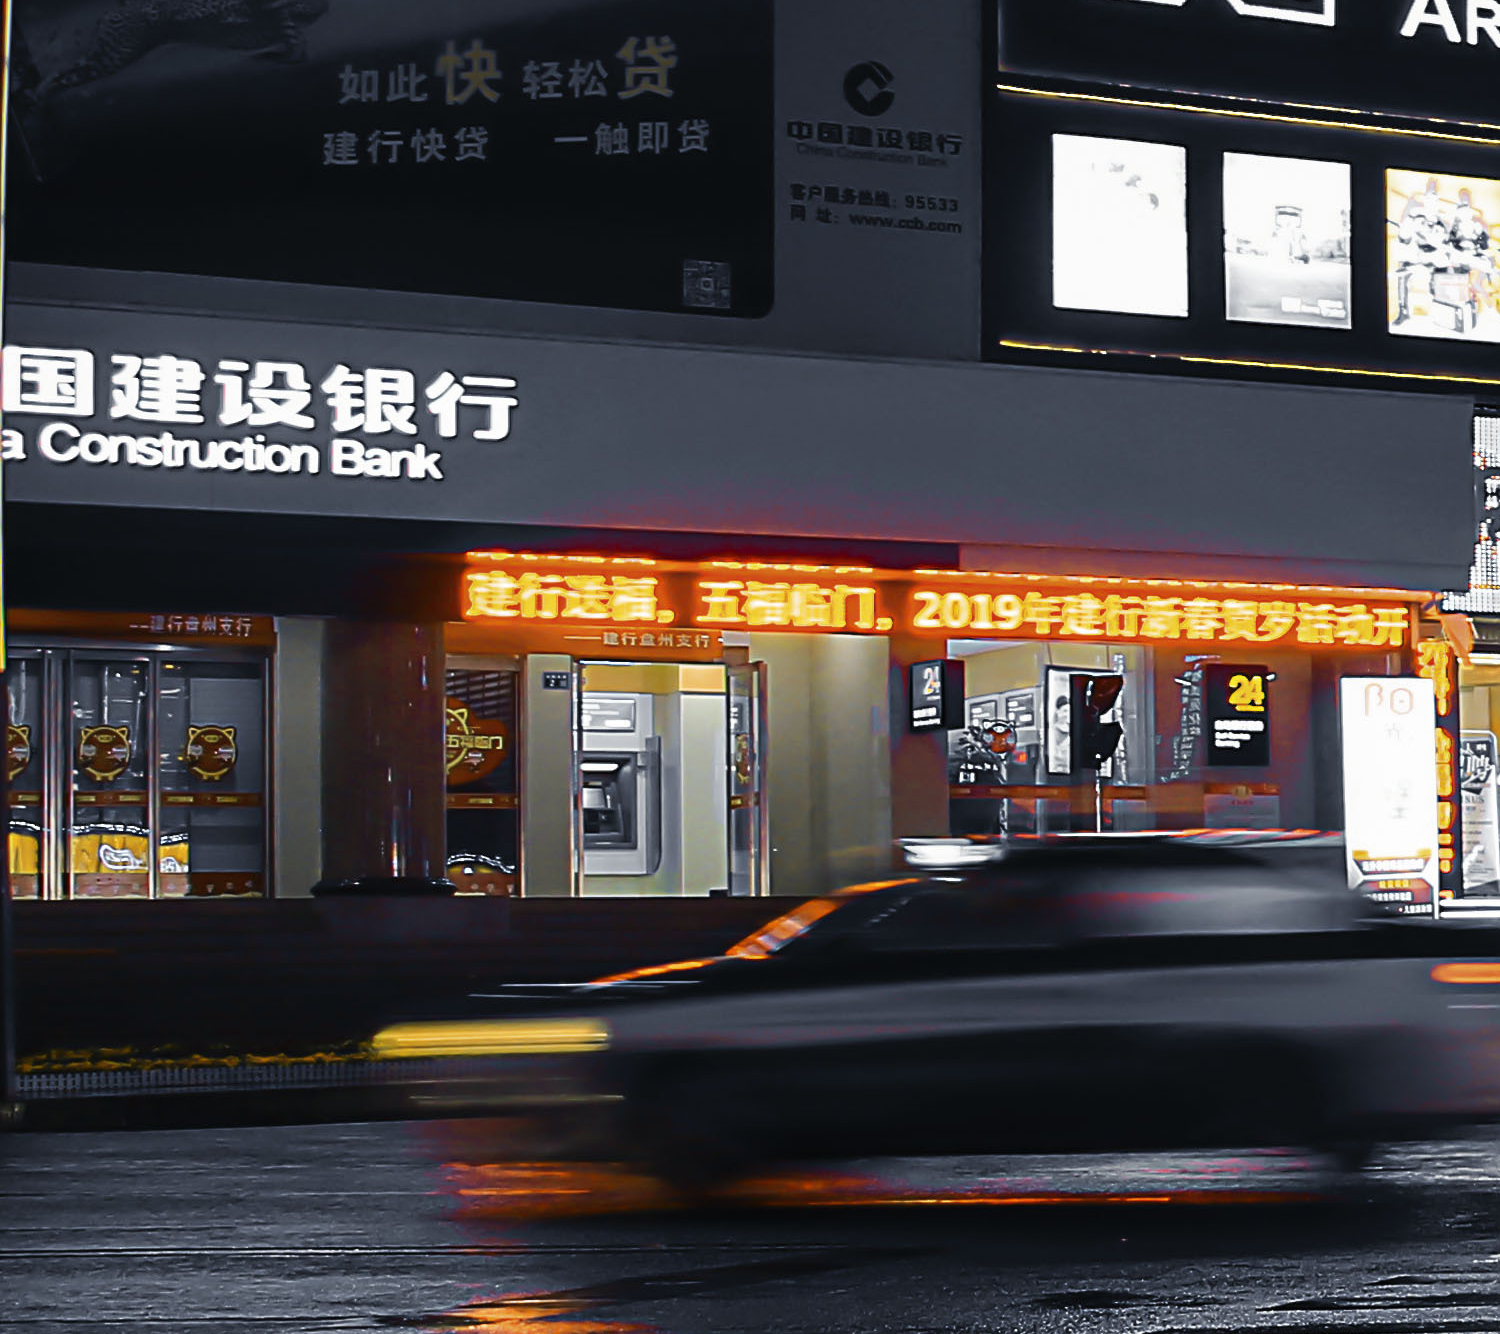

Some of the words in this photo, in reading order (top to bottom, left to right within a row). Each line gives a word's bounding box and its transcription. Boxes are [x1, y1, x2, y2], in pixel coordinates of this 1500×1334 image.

[337, 38, 503, 106] 如此快
[521, 35, 679, 100] 轻松贷
[321, 125, 490, 167] 建行快贷
[552, 119, 711, 156] 一触即贷
[787, 121, 962, 155] 中国建设银行
[905, 194, 959, 212] 95533
[849, 213, 962, 234] www.ccb.com
[38, 422, 320, 476] Construction
[331, 440, 445, 483] Bank
[1228, 674, 1265, 706] 24
